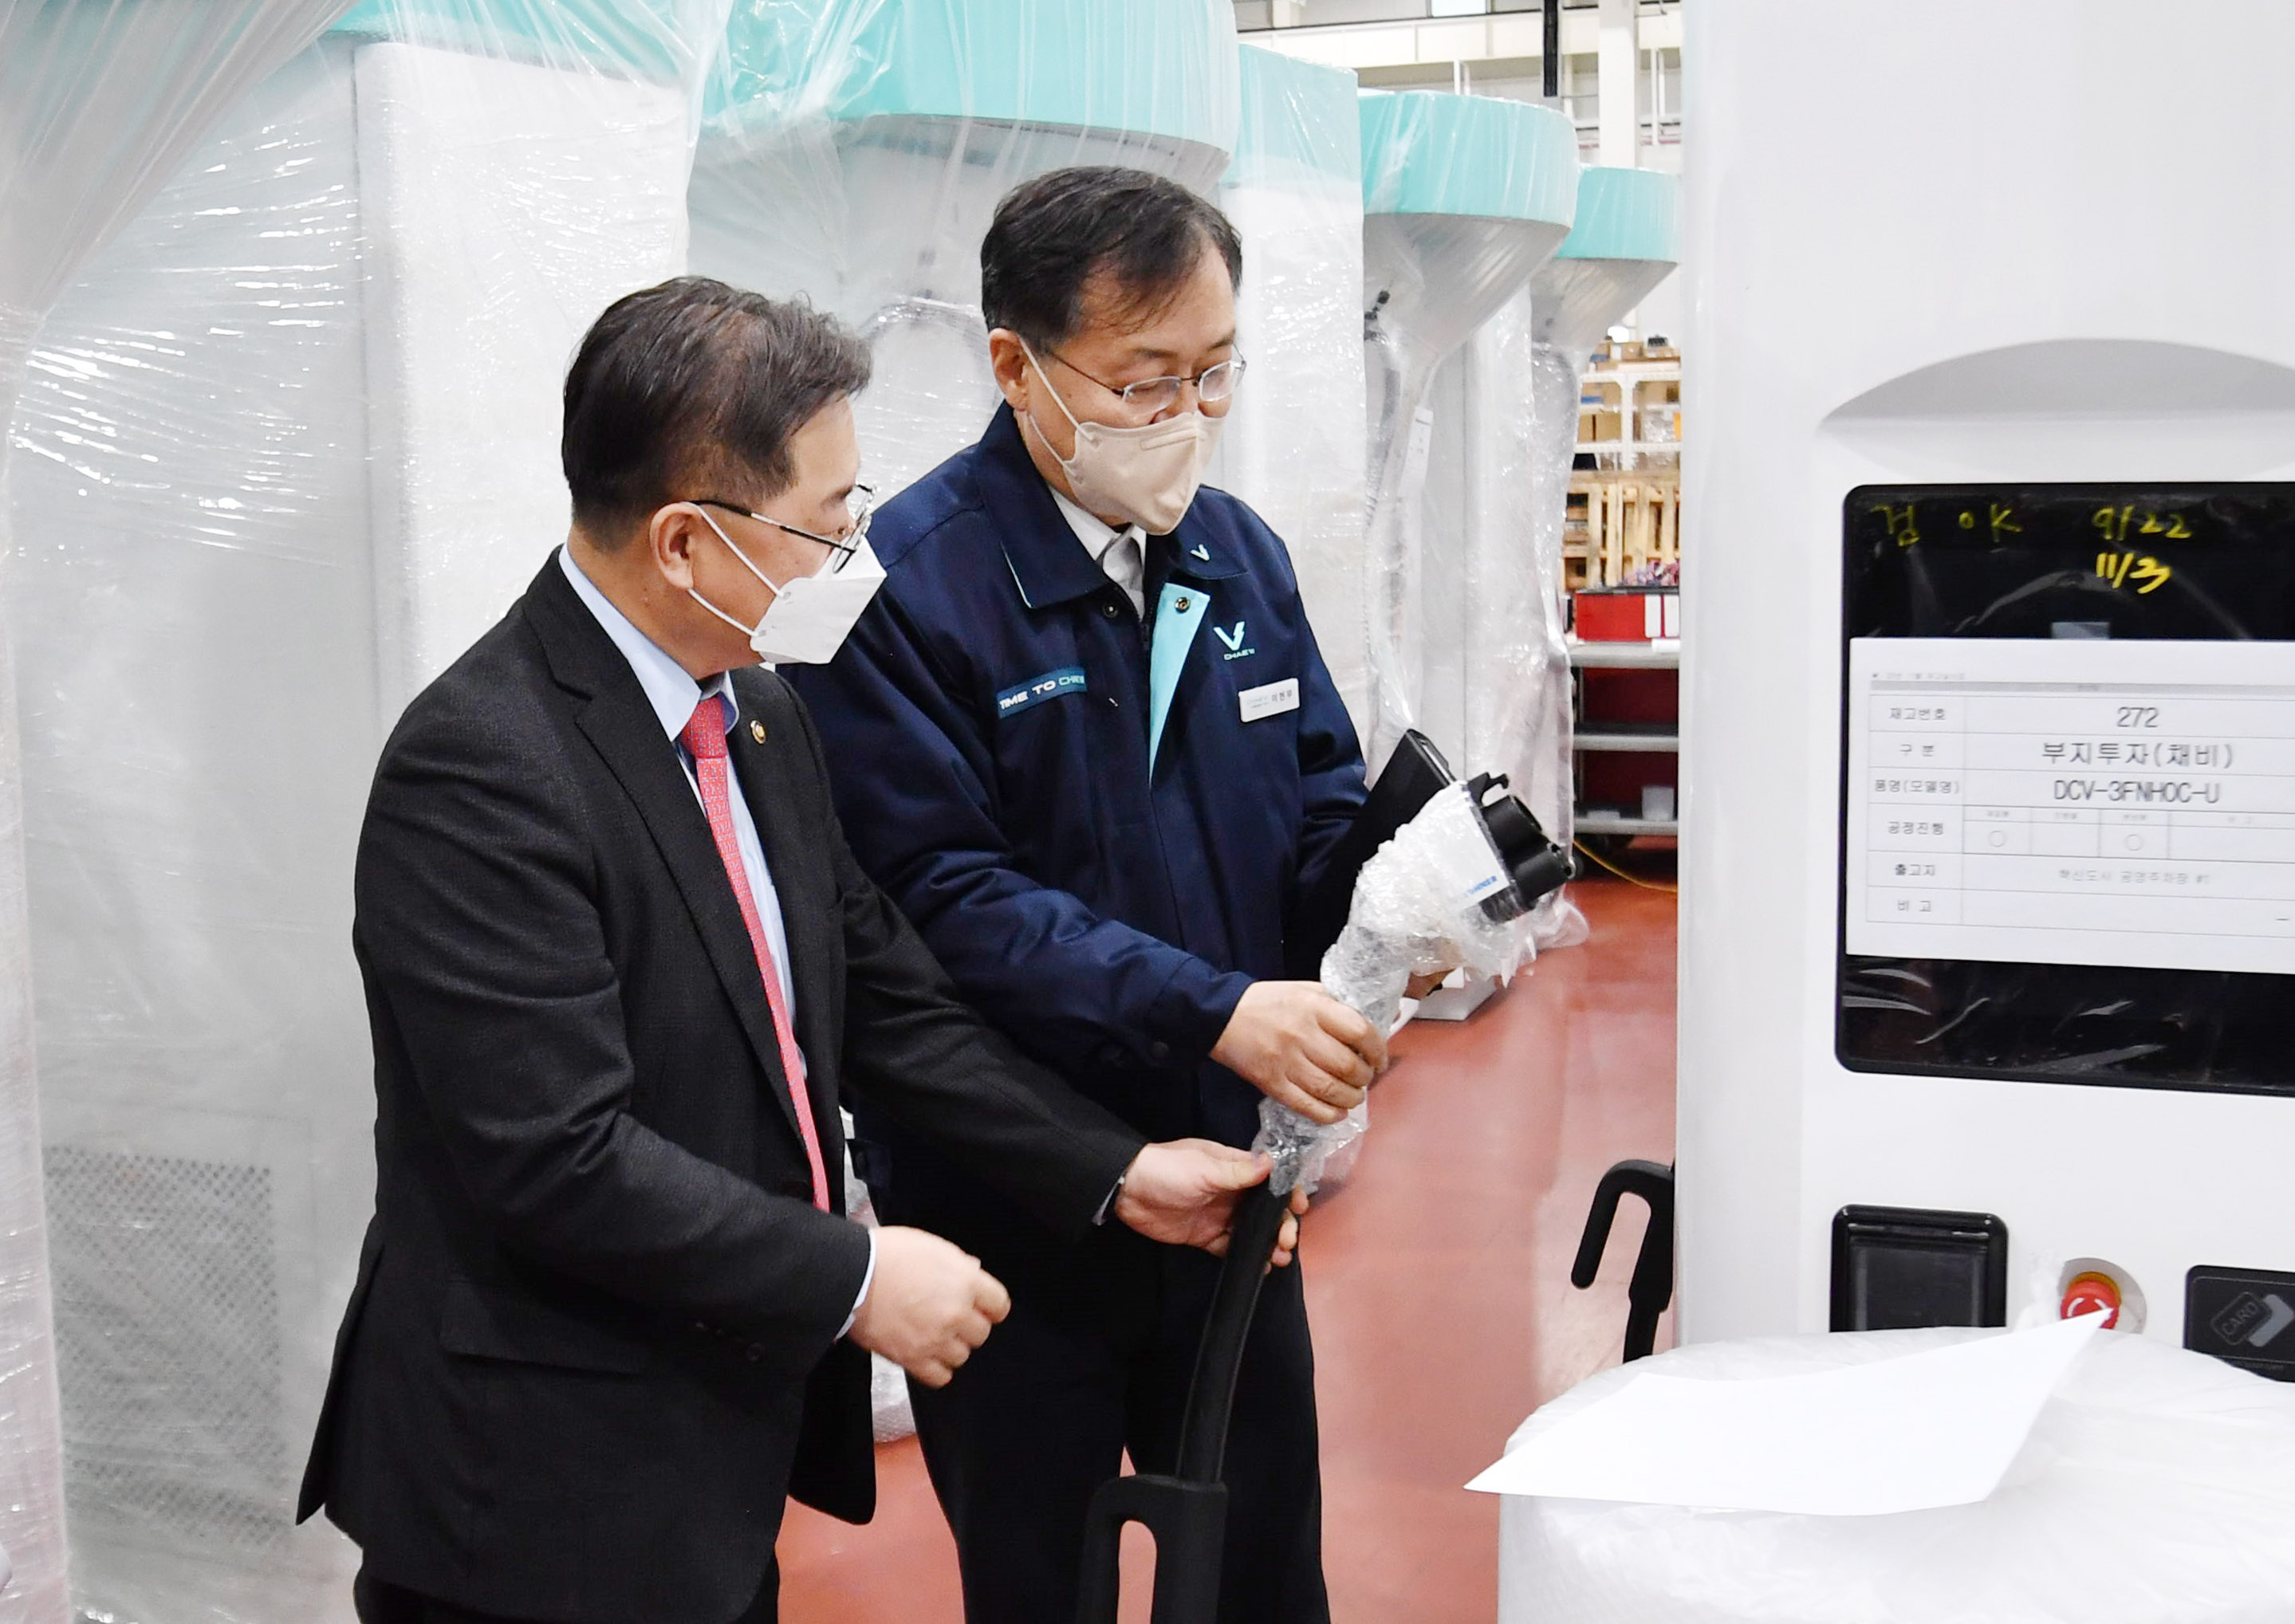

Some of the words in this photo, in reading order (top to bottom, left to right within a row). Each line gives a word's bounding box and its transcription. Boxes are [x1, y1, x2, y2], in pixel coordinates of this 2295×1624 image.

[2092, 504, 2193, 541] 9/22
[2096, 552, 2171, 594] 11/3
[999, 690, 1029, 710] TIME
[1032, 680, 1057, 695] TO
[1889, 707, 1946, 721] 재고번호
[2116, 706, 2159, 728] 272
[2042, 741, 2234, 769] 부지투자(채비)
[1888, 820, 1944, 836] 공정진행
[2221, 1300, 2260, 1336] CARD
